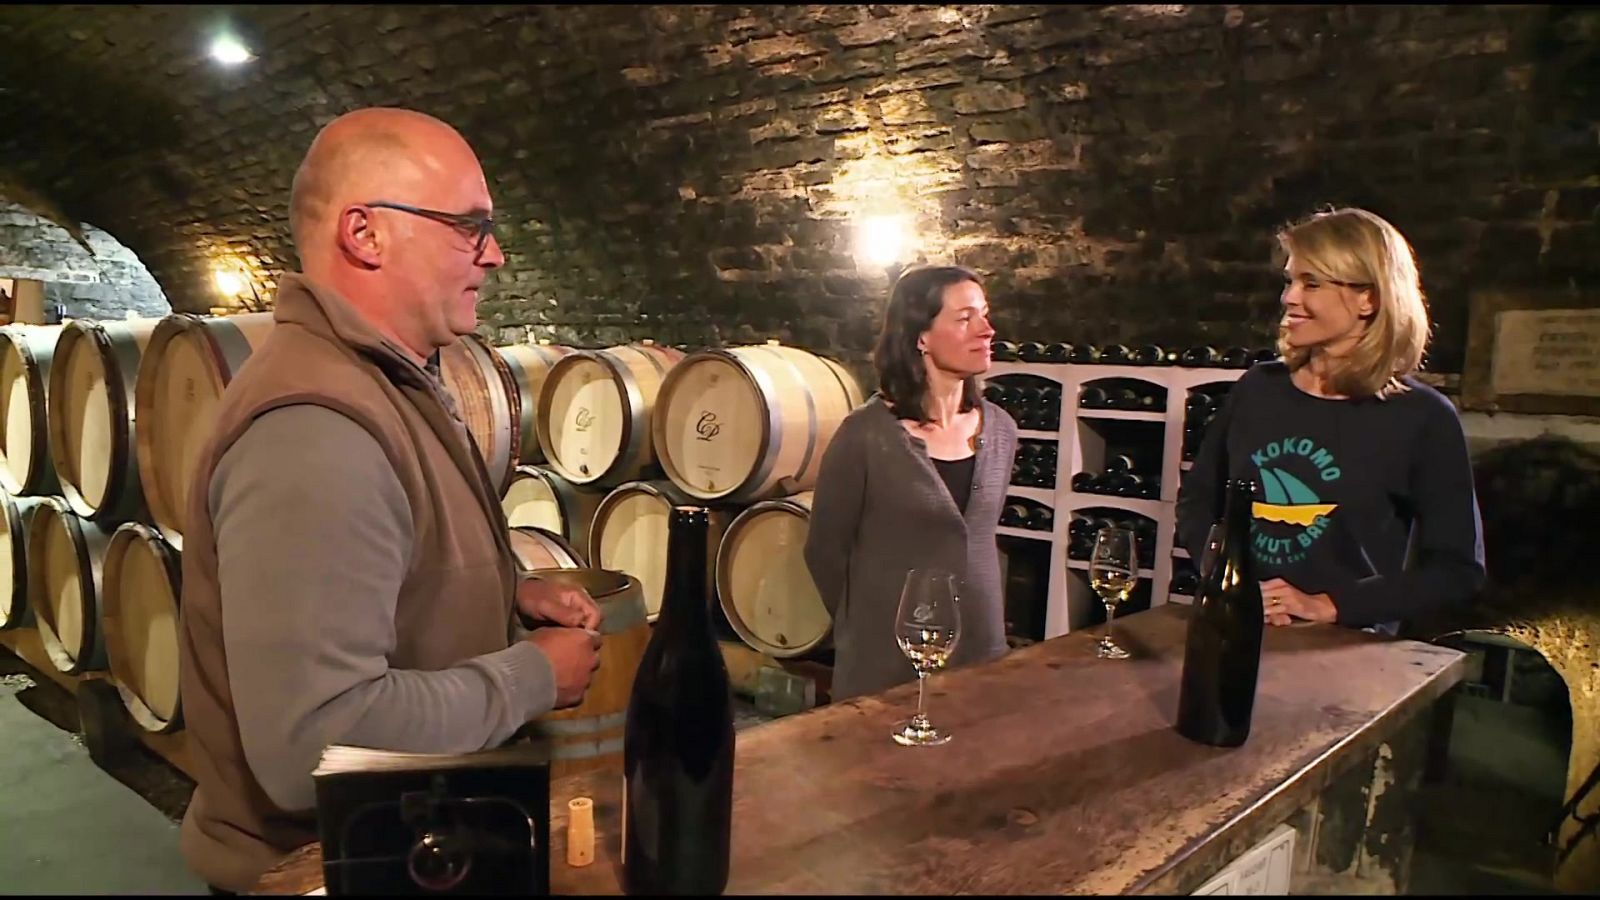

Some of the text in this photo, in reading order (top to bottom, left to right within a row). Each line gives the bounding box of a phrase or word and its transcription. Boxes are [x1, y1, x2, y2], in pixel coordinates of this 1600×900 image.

[1251, 436, 1341, 481] KOKOMO
[1255, 516, 1331, 553] HUT BAR
